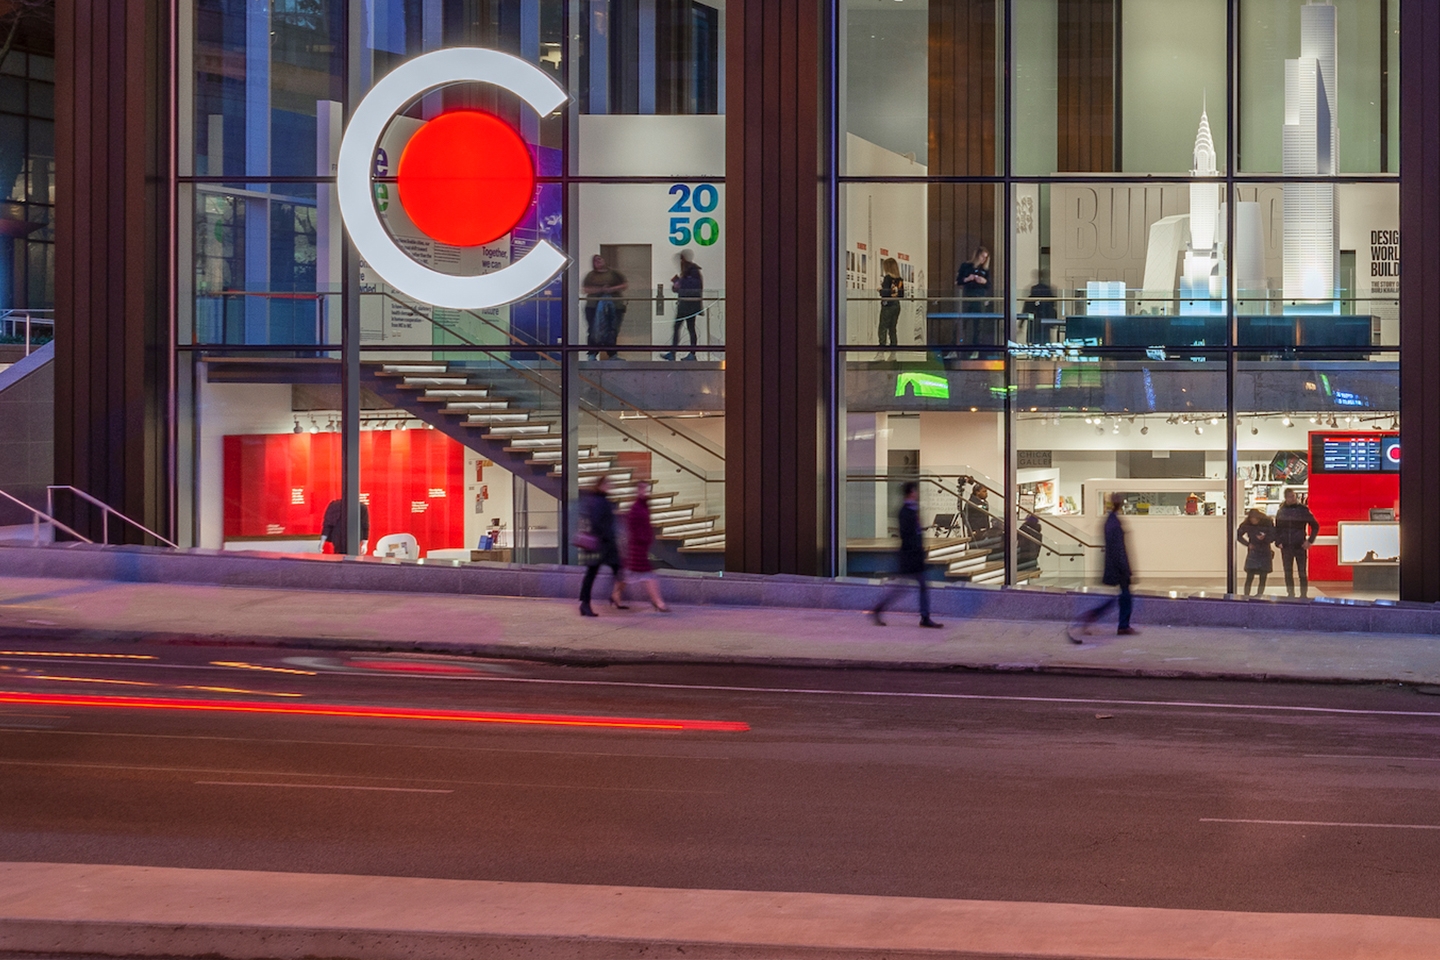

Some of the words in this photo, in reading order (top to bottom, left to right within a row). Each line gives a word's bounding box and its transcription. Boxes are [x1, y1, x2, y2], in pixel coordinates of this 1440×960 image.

[667, 183, 719, 213] 20
[668, 216, 720, 247] 50
[482, 246, 508, 259] Together,
